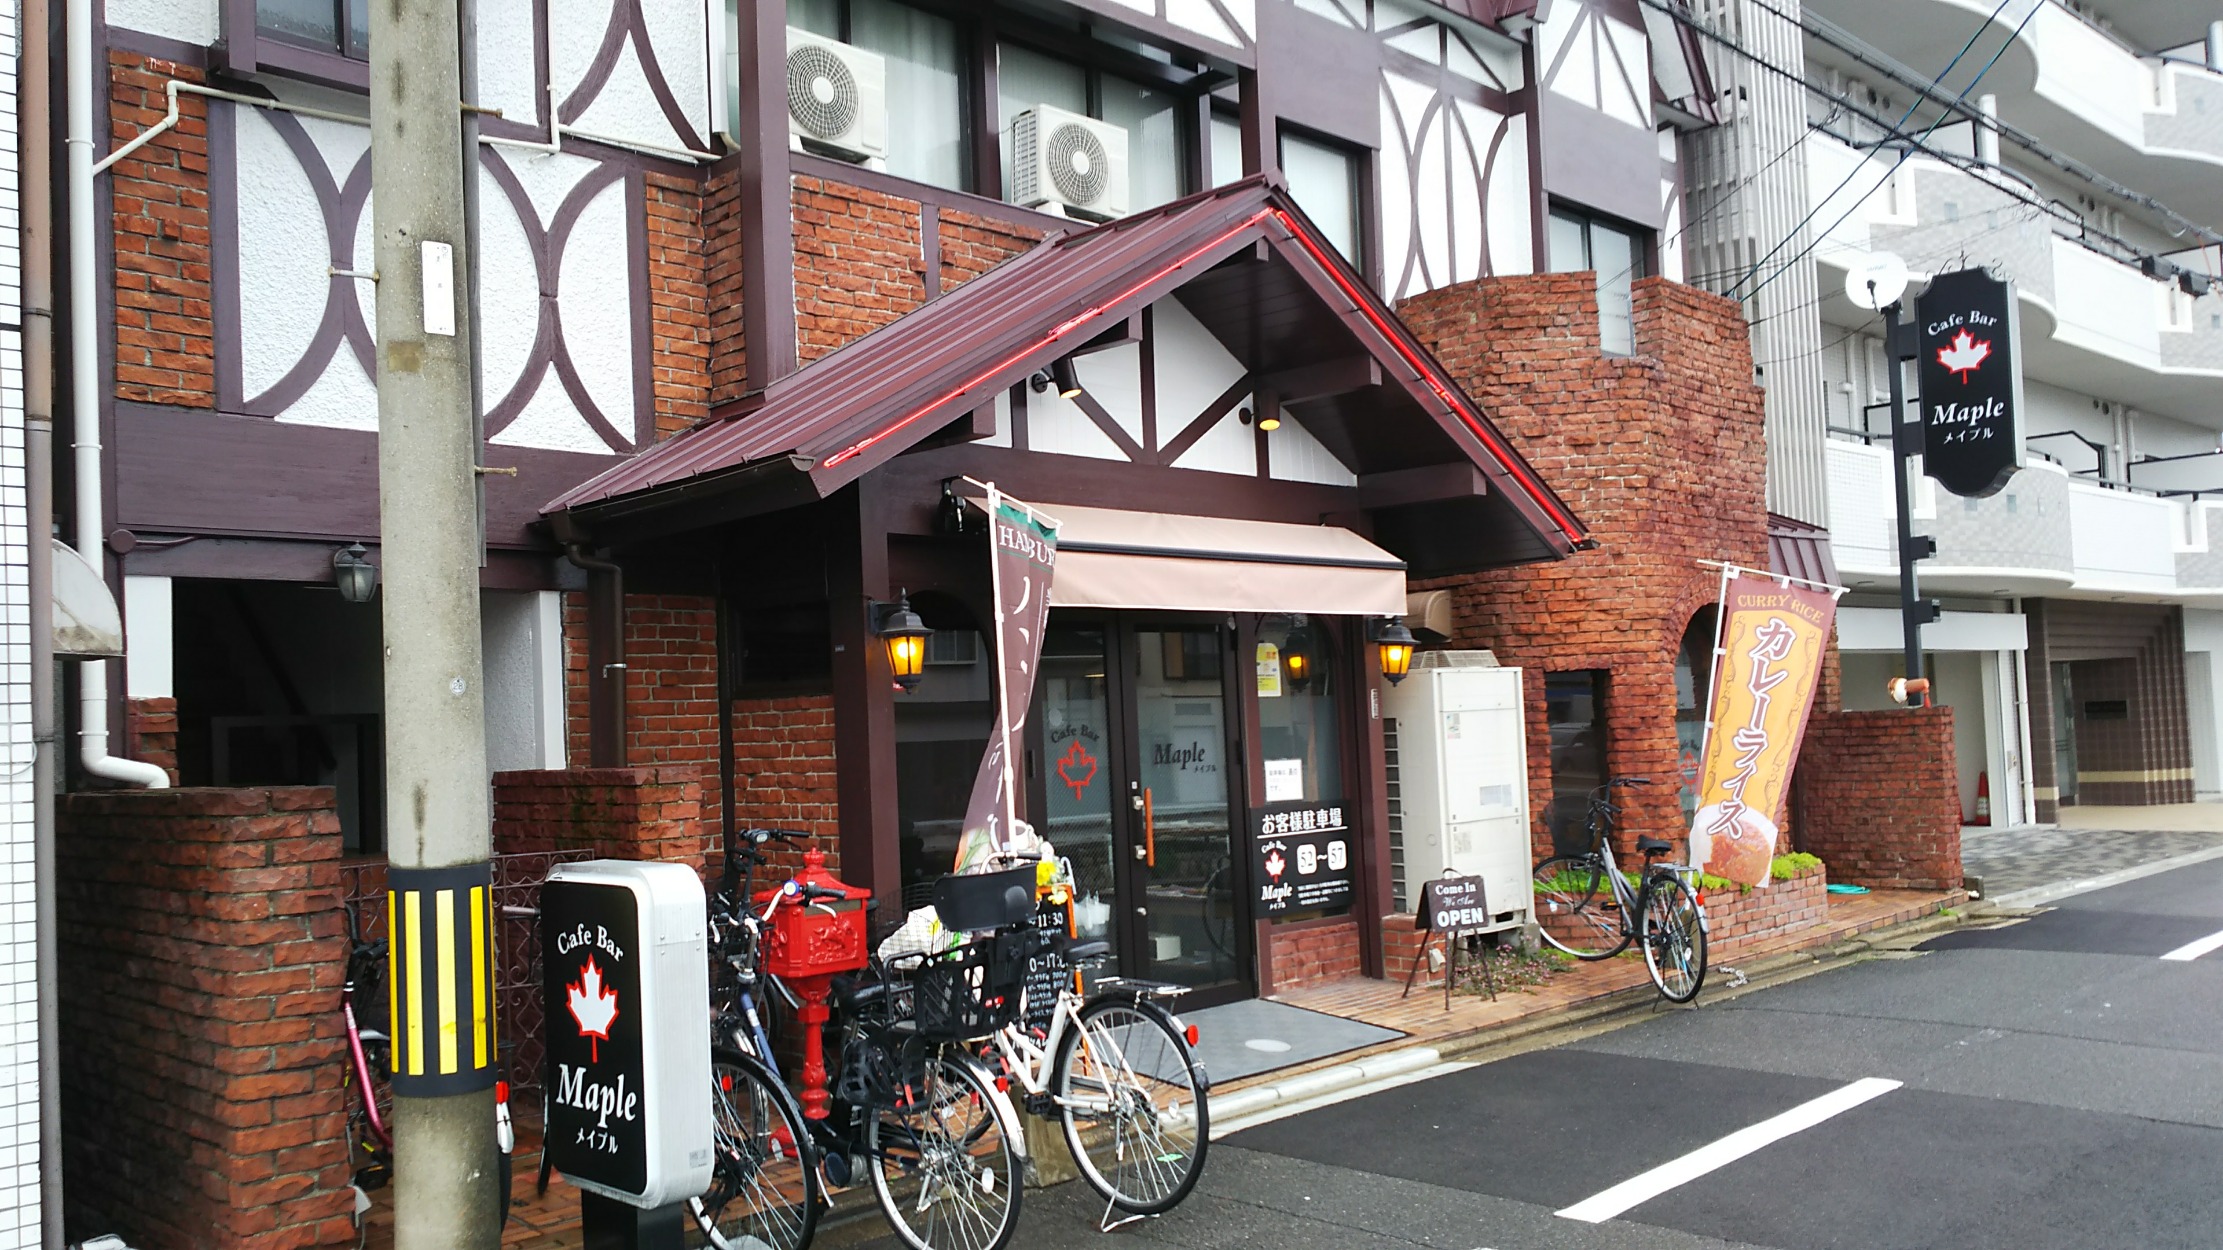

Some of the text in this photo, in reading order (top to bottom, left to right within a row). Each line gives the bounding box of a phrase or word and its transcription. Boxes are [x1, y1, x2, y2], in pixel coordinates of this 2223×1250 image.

[1927, 310, 1998, 336] Cafe Bar
[1931, 396, 2005, 427] Maple
[1737, 594, 1825, 624] CURRY RICE
[1051, 724, 1100, 745] Cafe Bar
[1706, 617, 1797, 840] カレーライス
[1153, 741, 1206, 771] Maple
[1261, 807, 1343, 834] お客様駐車場
[1261, 882, 1293, 902] Maple
[1435, 882, 1477, 895] Come In
[1437, 907, 1484, 928] OPEN
[557, 923, 624, 962] Cafe Bar
[556, 1063, 637, 1129] Maple
